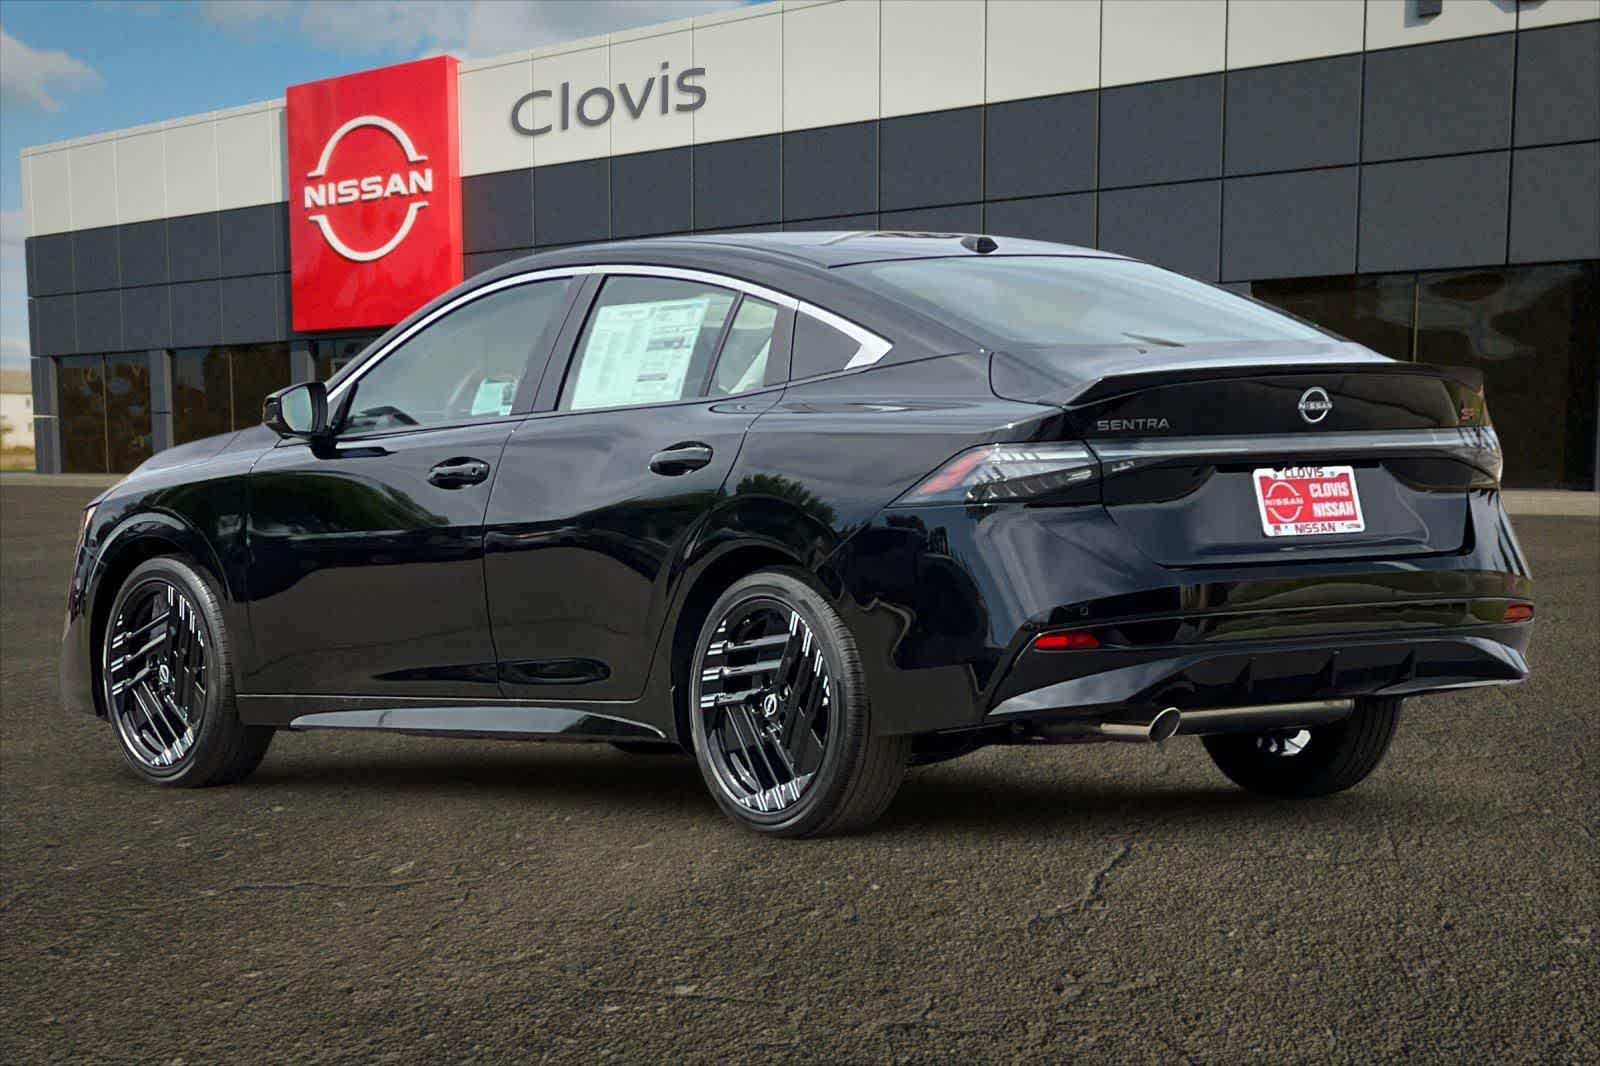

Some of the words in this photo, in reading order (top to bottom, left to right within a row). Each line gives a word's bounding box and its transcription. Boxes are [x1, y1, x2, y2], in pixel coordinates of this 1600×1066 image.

[511, 61, 707, 136] Clovis
[304, 168, 433, 208] NISSAN
[1097, 418, 1170, 431] SENTRA
[1284, 467, 1324, 479] CLOVIS
[1309, 482, 1350, 498] CLOVIS
[1312, 501, 1355, 517] NISSAN
[1295, 522, 1336, 534] NISSAN
